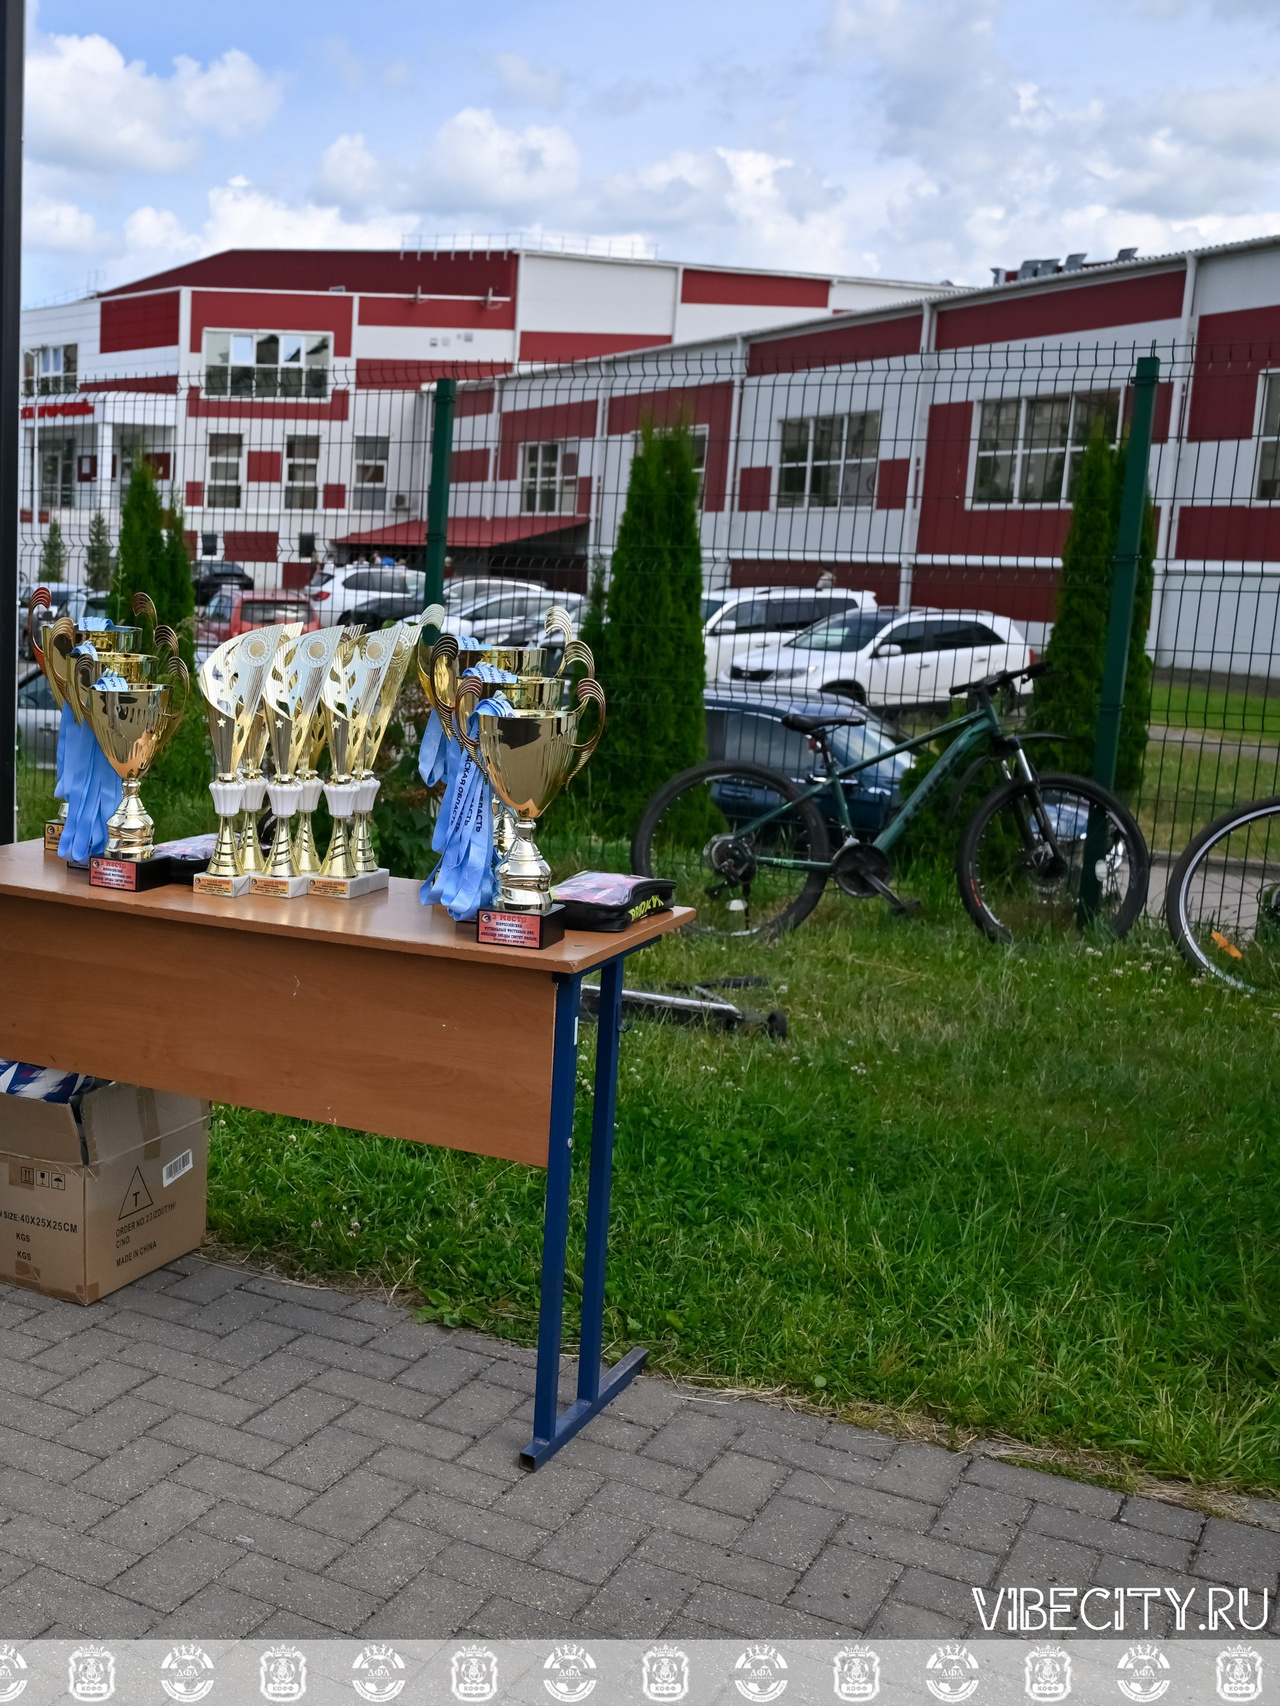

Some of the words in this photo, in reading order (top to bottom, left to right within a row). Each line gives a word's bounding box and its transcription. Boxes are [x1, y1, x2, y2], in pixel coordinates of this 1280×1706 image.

[450, 786, 464, 826] ОБЛАСТЬ
[500, 914, 527, 923] МЕСТО
[133, 1191, 140, 1207] T
[15, 1232, 31, 1242] KGS
[116, 1221, 135, 1237] ORDER
[16, 1250, 31, 1261] KGS
[116, 1253, 132, 1267] MADE
[139, 1240, 157, 1256] CHINA
